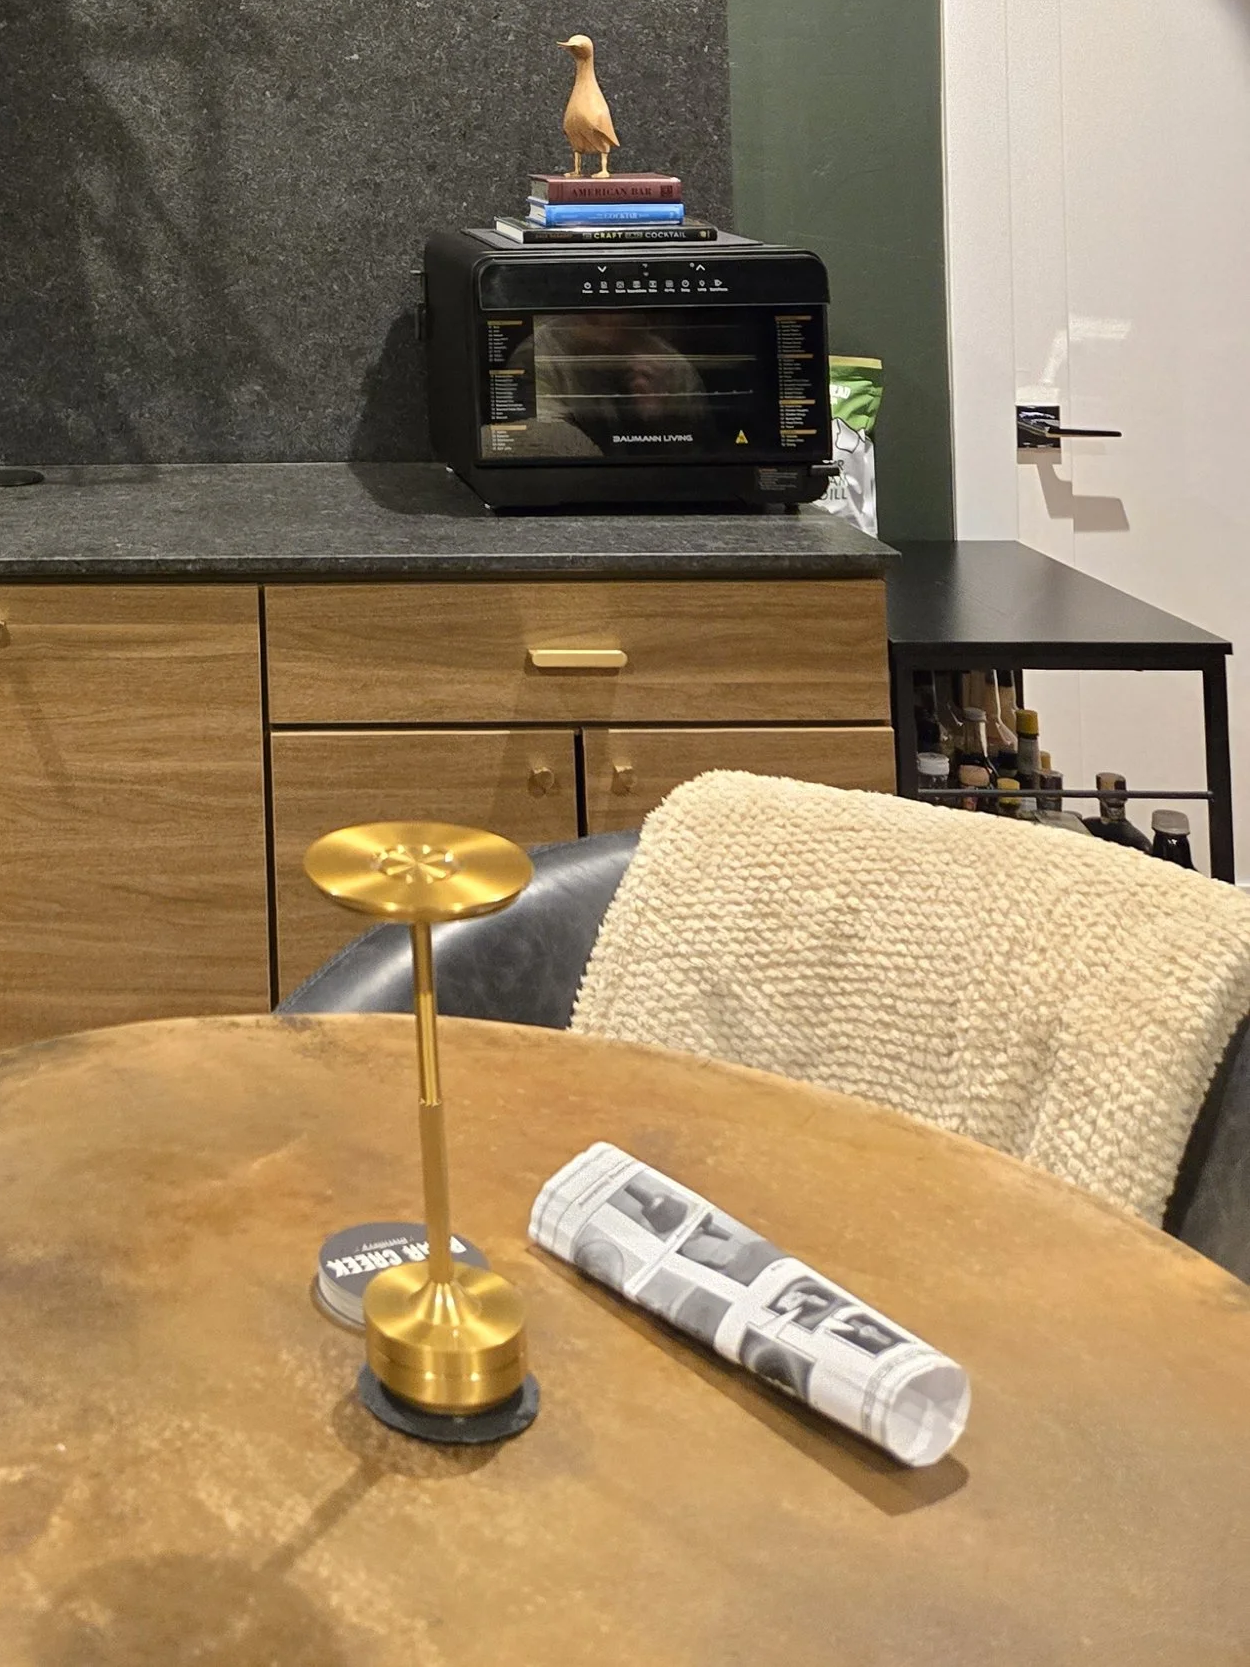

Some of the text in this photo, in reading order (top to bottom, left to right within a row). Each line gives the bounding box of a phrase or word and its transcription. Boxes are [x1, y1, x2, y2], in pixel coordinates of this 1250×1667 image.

[572, 187, 653, 197] AMERICAN BAR
[593, 232, 623, 240] CRAFT
[645, 231, 687, 239] COCKTAIL
[612, 434, 693, 443] BAUMANN LIVING
[325, 1248, 403, 1279] CREEK
